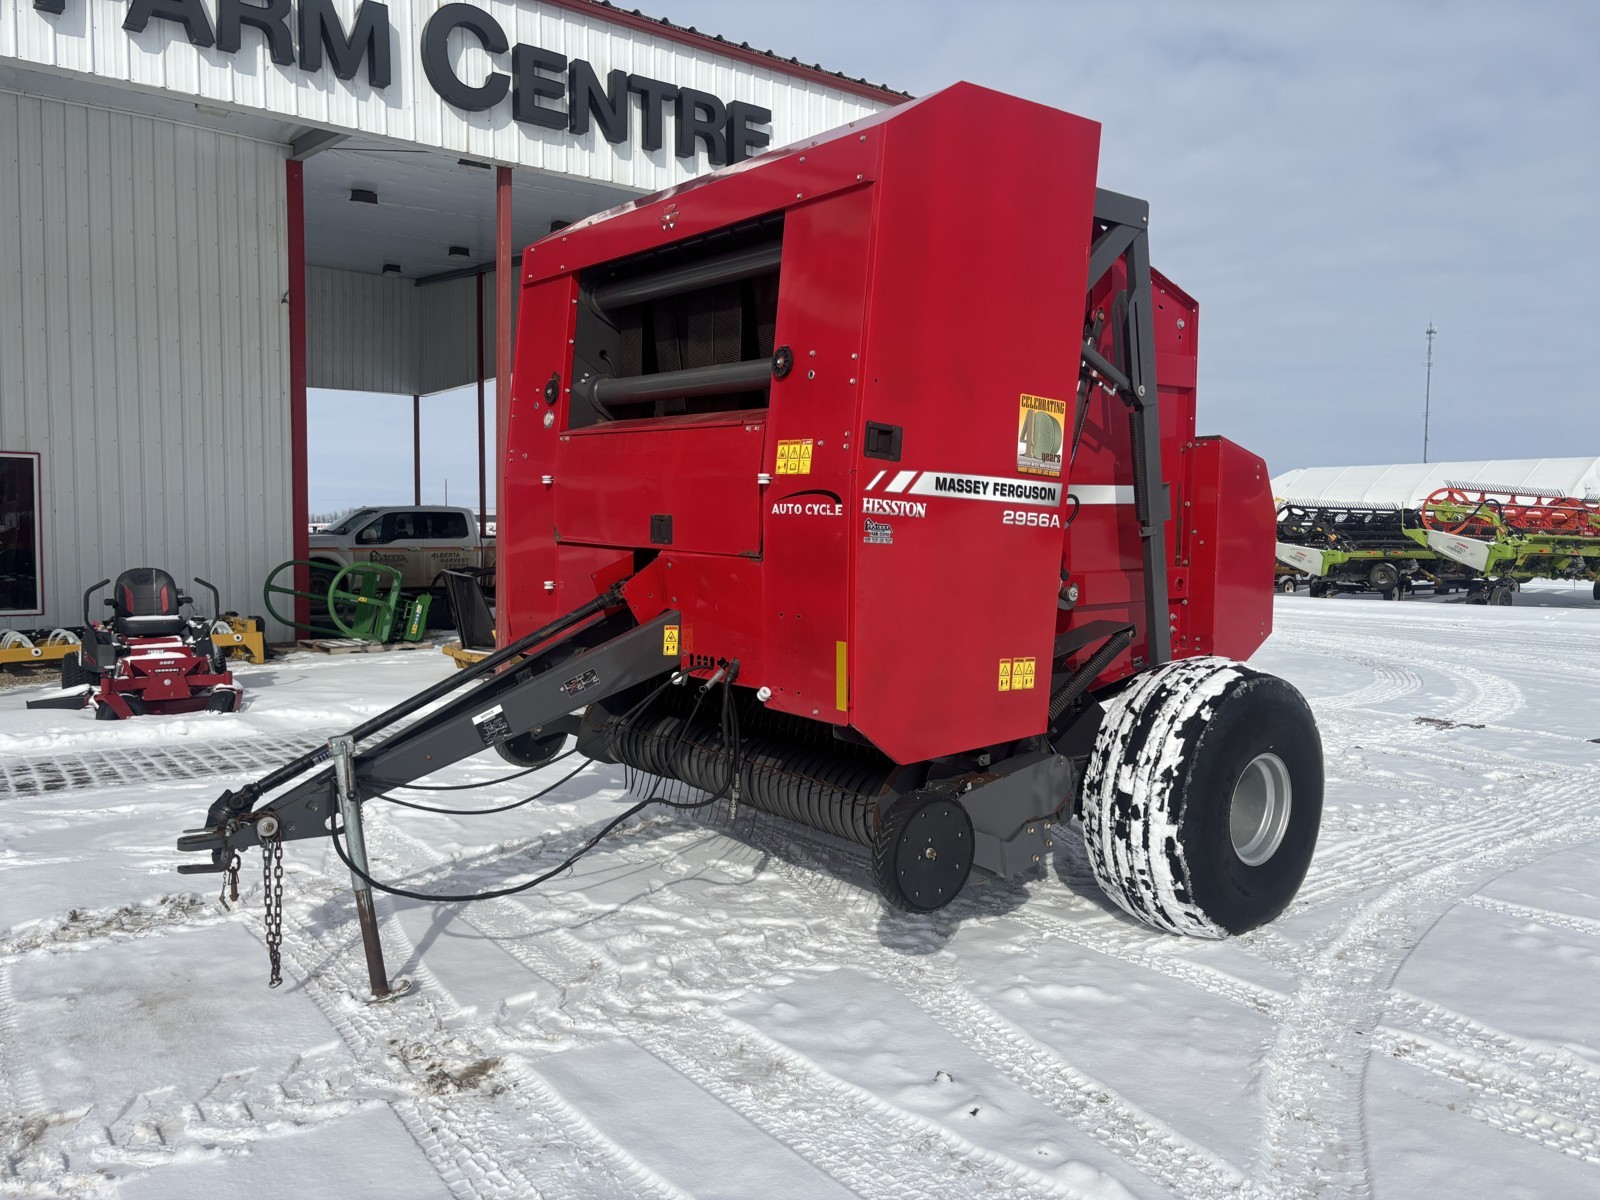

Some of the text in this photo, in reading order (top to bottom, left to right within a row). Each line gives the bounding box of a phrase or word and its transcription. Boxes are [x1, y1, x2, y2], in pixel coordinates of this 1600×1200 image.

[33, 0, 772, 166] ARM CENTRE
[1021, 395, 1065, 414] CELEBRATING
[1041, 452, 1061, 463] years
[935, 476, 1056, 501] MASSEY FERGUSON
[771, 503, 843, 516] AUTO CYCLE
[862, 497, 927, 519] HESSTON
[1003, 510, 1060, 528] 2956A
[431, 552, 460, 560] ALBERTA
